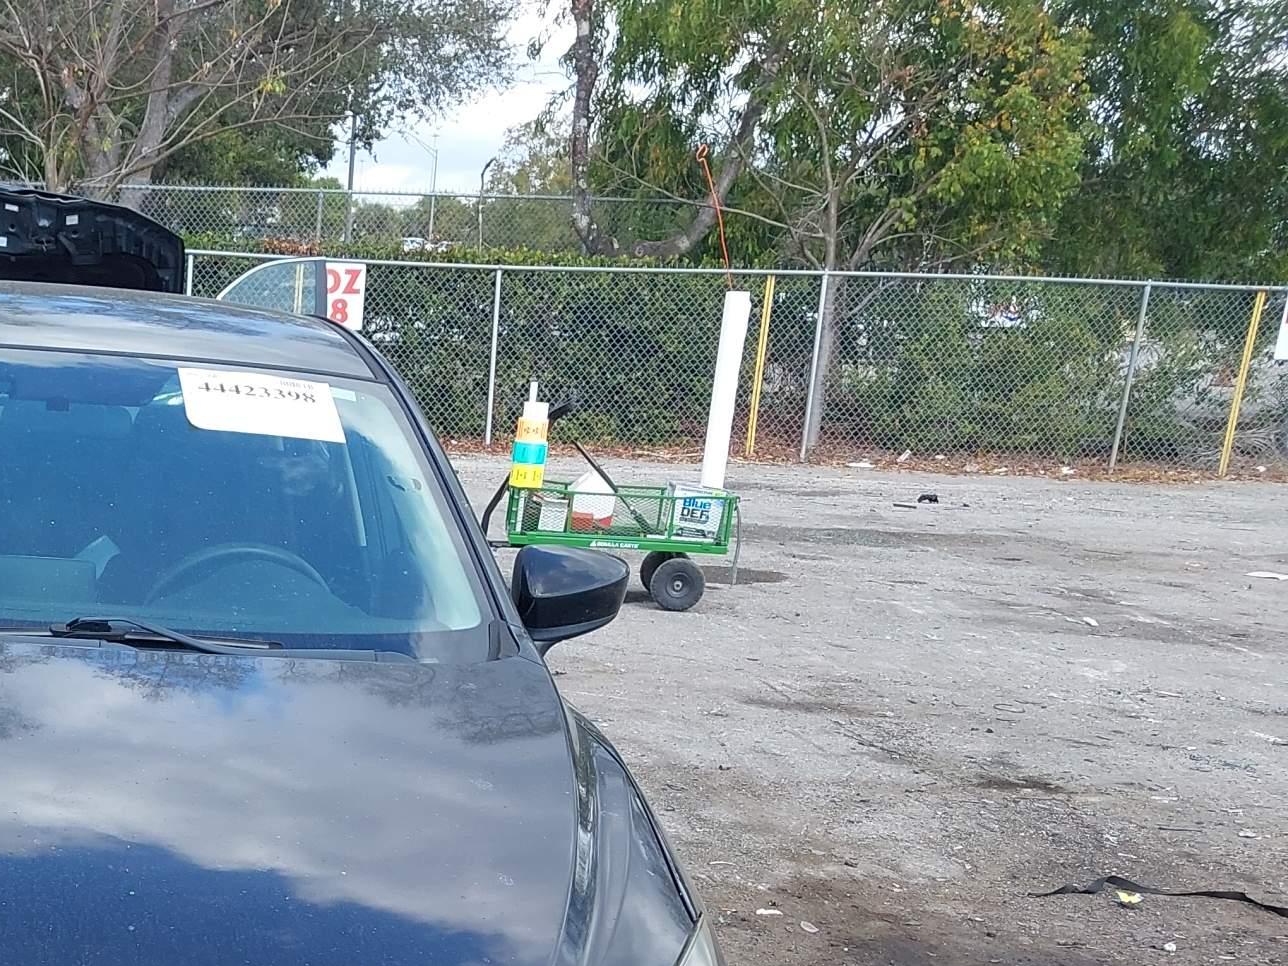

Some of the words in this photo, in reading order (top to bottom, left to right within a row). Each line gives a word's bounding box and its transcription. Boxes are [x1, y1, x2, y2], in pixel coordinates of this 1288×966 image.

[330, 298, 348, 323] 8
[198, 382, 316, 403] 44423398
[683, 497, 712, 509] Blue
